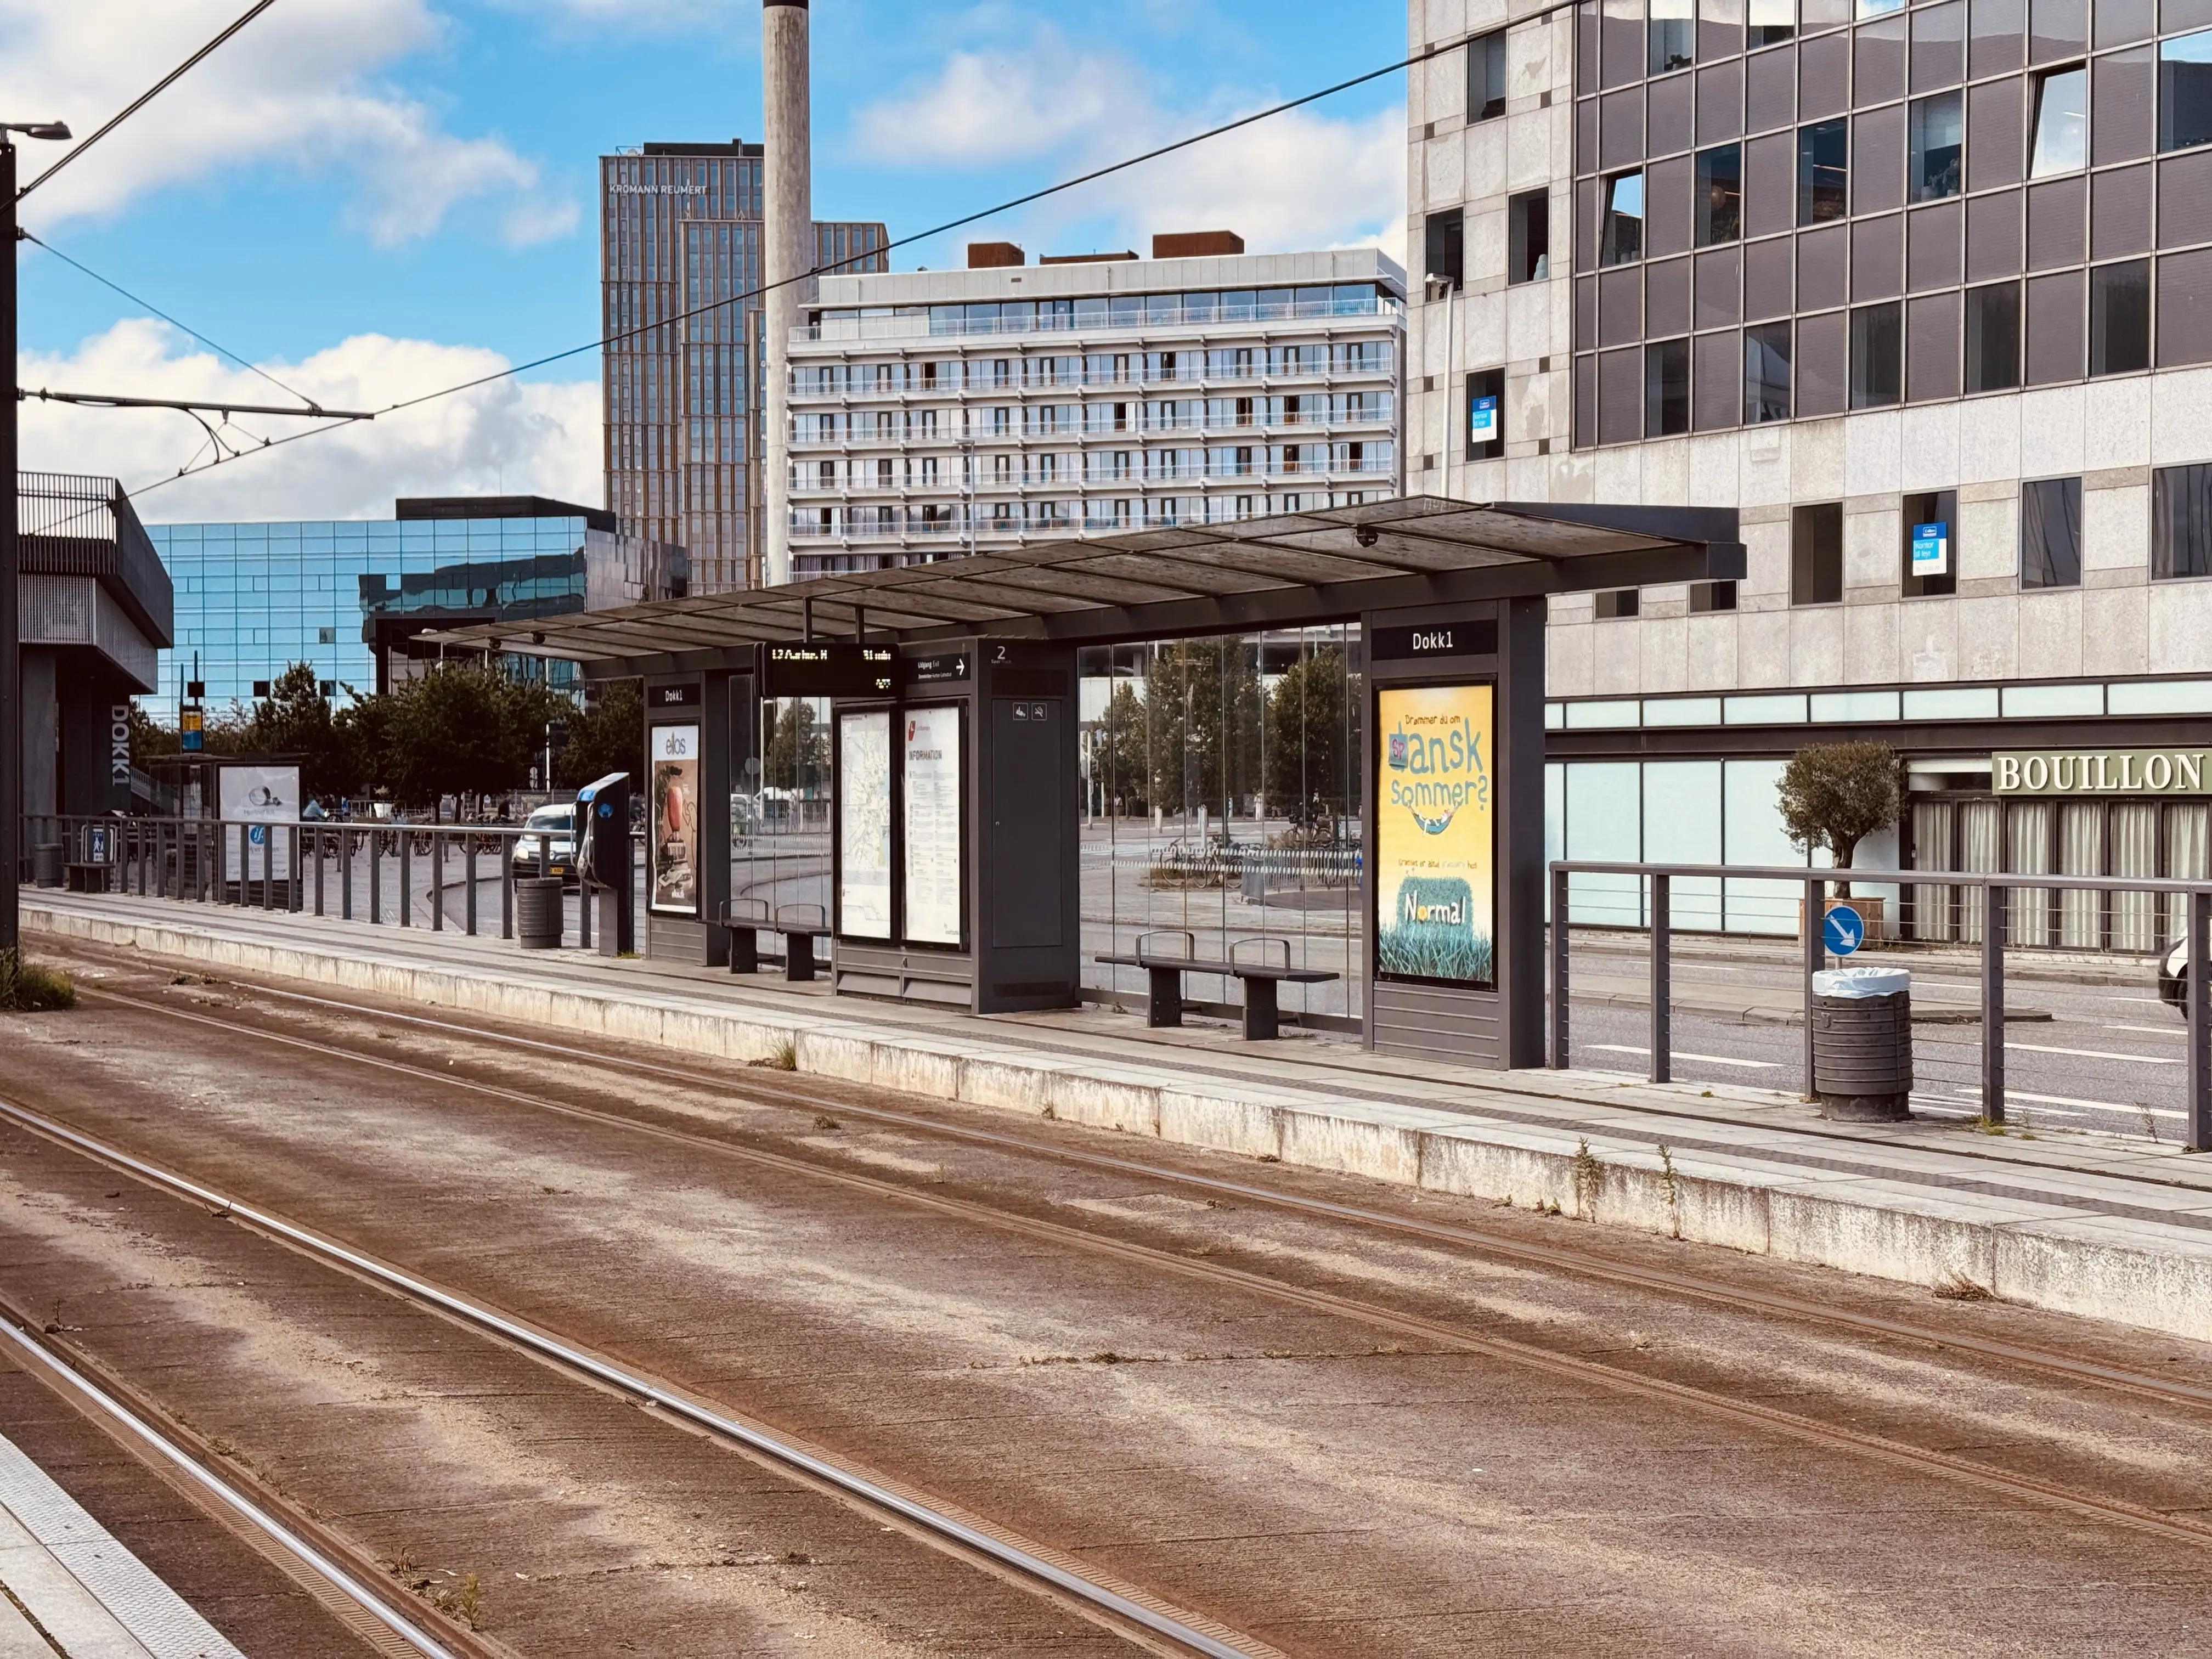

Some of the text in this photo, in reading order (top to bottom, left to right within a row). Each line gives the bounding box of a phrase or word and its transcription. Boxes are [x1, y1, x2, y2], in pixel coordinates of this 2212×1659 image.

[610, 184, 707, 194] KROMANN REUMERT
[1413, 631, 1453, 650] Dokk1
[997, 646, 1006, 659] 2
[665, 689, 683, 702] Dokk1
[1440, 714, 1448, 725] du
[1449, 715, 1461, 724] om
[112, 705, 130, 787] DOKK1
[665, 731, 686, 755] ellos
[909, 749, 943, 761] INFORMATION
[1997, 754, 2204, 790] BOUILLON
[1391, 774, 1488, 811] sommer?
[1405, 889, 1466, 924] Normal
